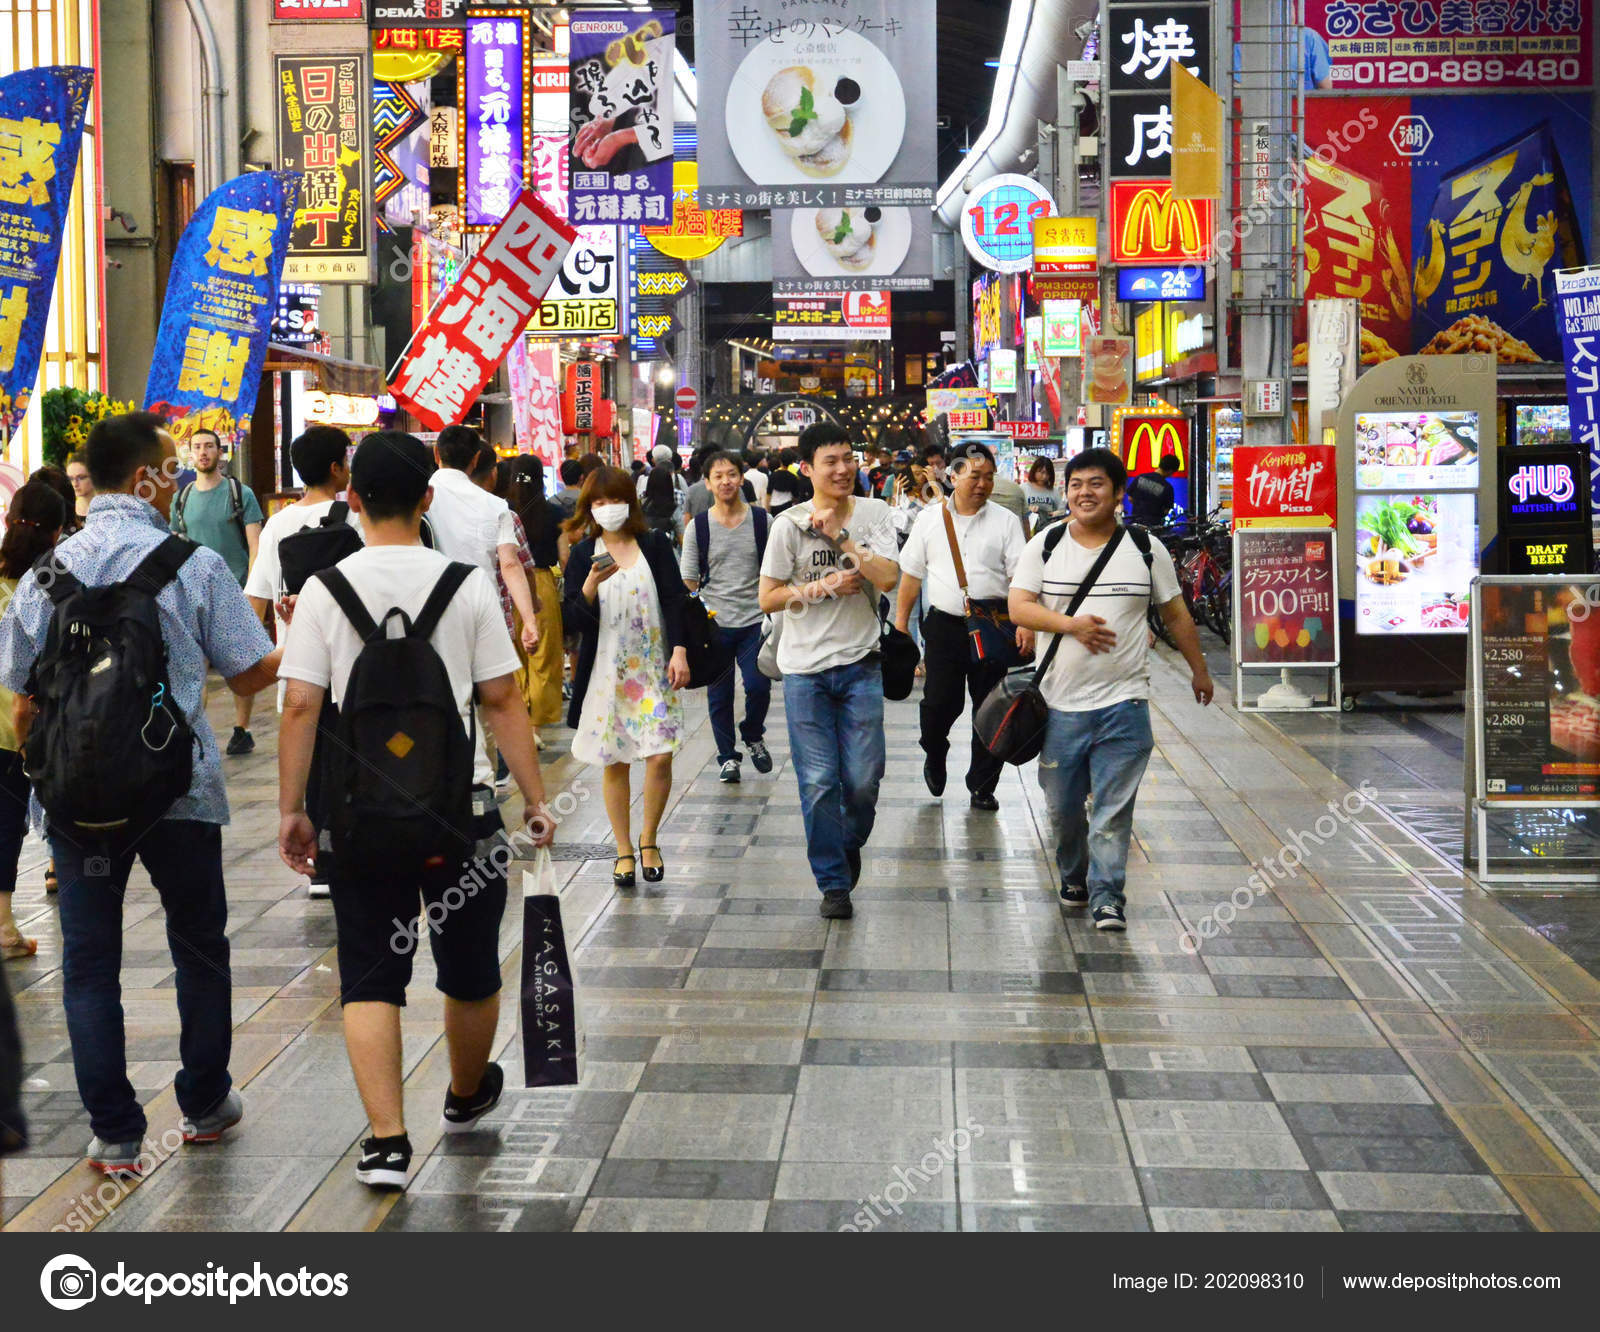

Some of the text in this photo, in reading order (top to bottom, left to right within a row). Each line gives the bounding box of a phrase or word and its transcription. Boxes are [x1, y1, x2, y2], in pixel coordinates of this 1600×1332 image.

[375, 8, 455, 18] DEMAND
[1325, 0, 1583, 37] あさひ美容外科
[572, 22, 623, 32] GENROKU
[728, 6, 903, 47] 幸せのパンケーキ
[1354, 59, 1580, 83] 0120-889-480
[339, 62, 357, 146] ご当地酒場
[432, 111, 449, 166] 大阪下町焼
[1399, 124, 1424, 149] 湖
[300, 66, 341, 247] 日の出横丁
[577, 174, 606, 187] 元祖
[703, 188, 838, 207] ミナミの街を美しく！
[844, 187, 933, 200] ミナミ千日前商店会
[574, 194, 667, 221] 元禄寿司
[203, 206, 279, 277] 感
[207, 275, 258, 295] おかげさまで、
[1036, 281, 1095, 290] PM3:00より
[1161, 290, 1188, 298] OPEN
[177, 327, 251, 403] 謝
[1374, 394, 1458, 406] ORIENTAL HOTEL
[1398, 386, 1437, 396] NAMBA
[1508, 464, 1575, 503] HUB
[1280, 503, 1313, 513] Pizza
[1512, 502, 1577, 513] BRITISH PUB
[812, 550, 837, 567] CON
[1526, 544, 1568, 555] DRAFT
[1530, 554, 1565, 565] BEER
[1244, 567, 1329, 588] グラスワイン
[534, 963, 544, 1019] AIRPORT
[542, 917, 563, 1063] NAGASAKI
